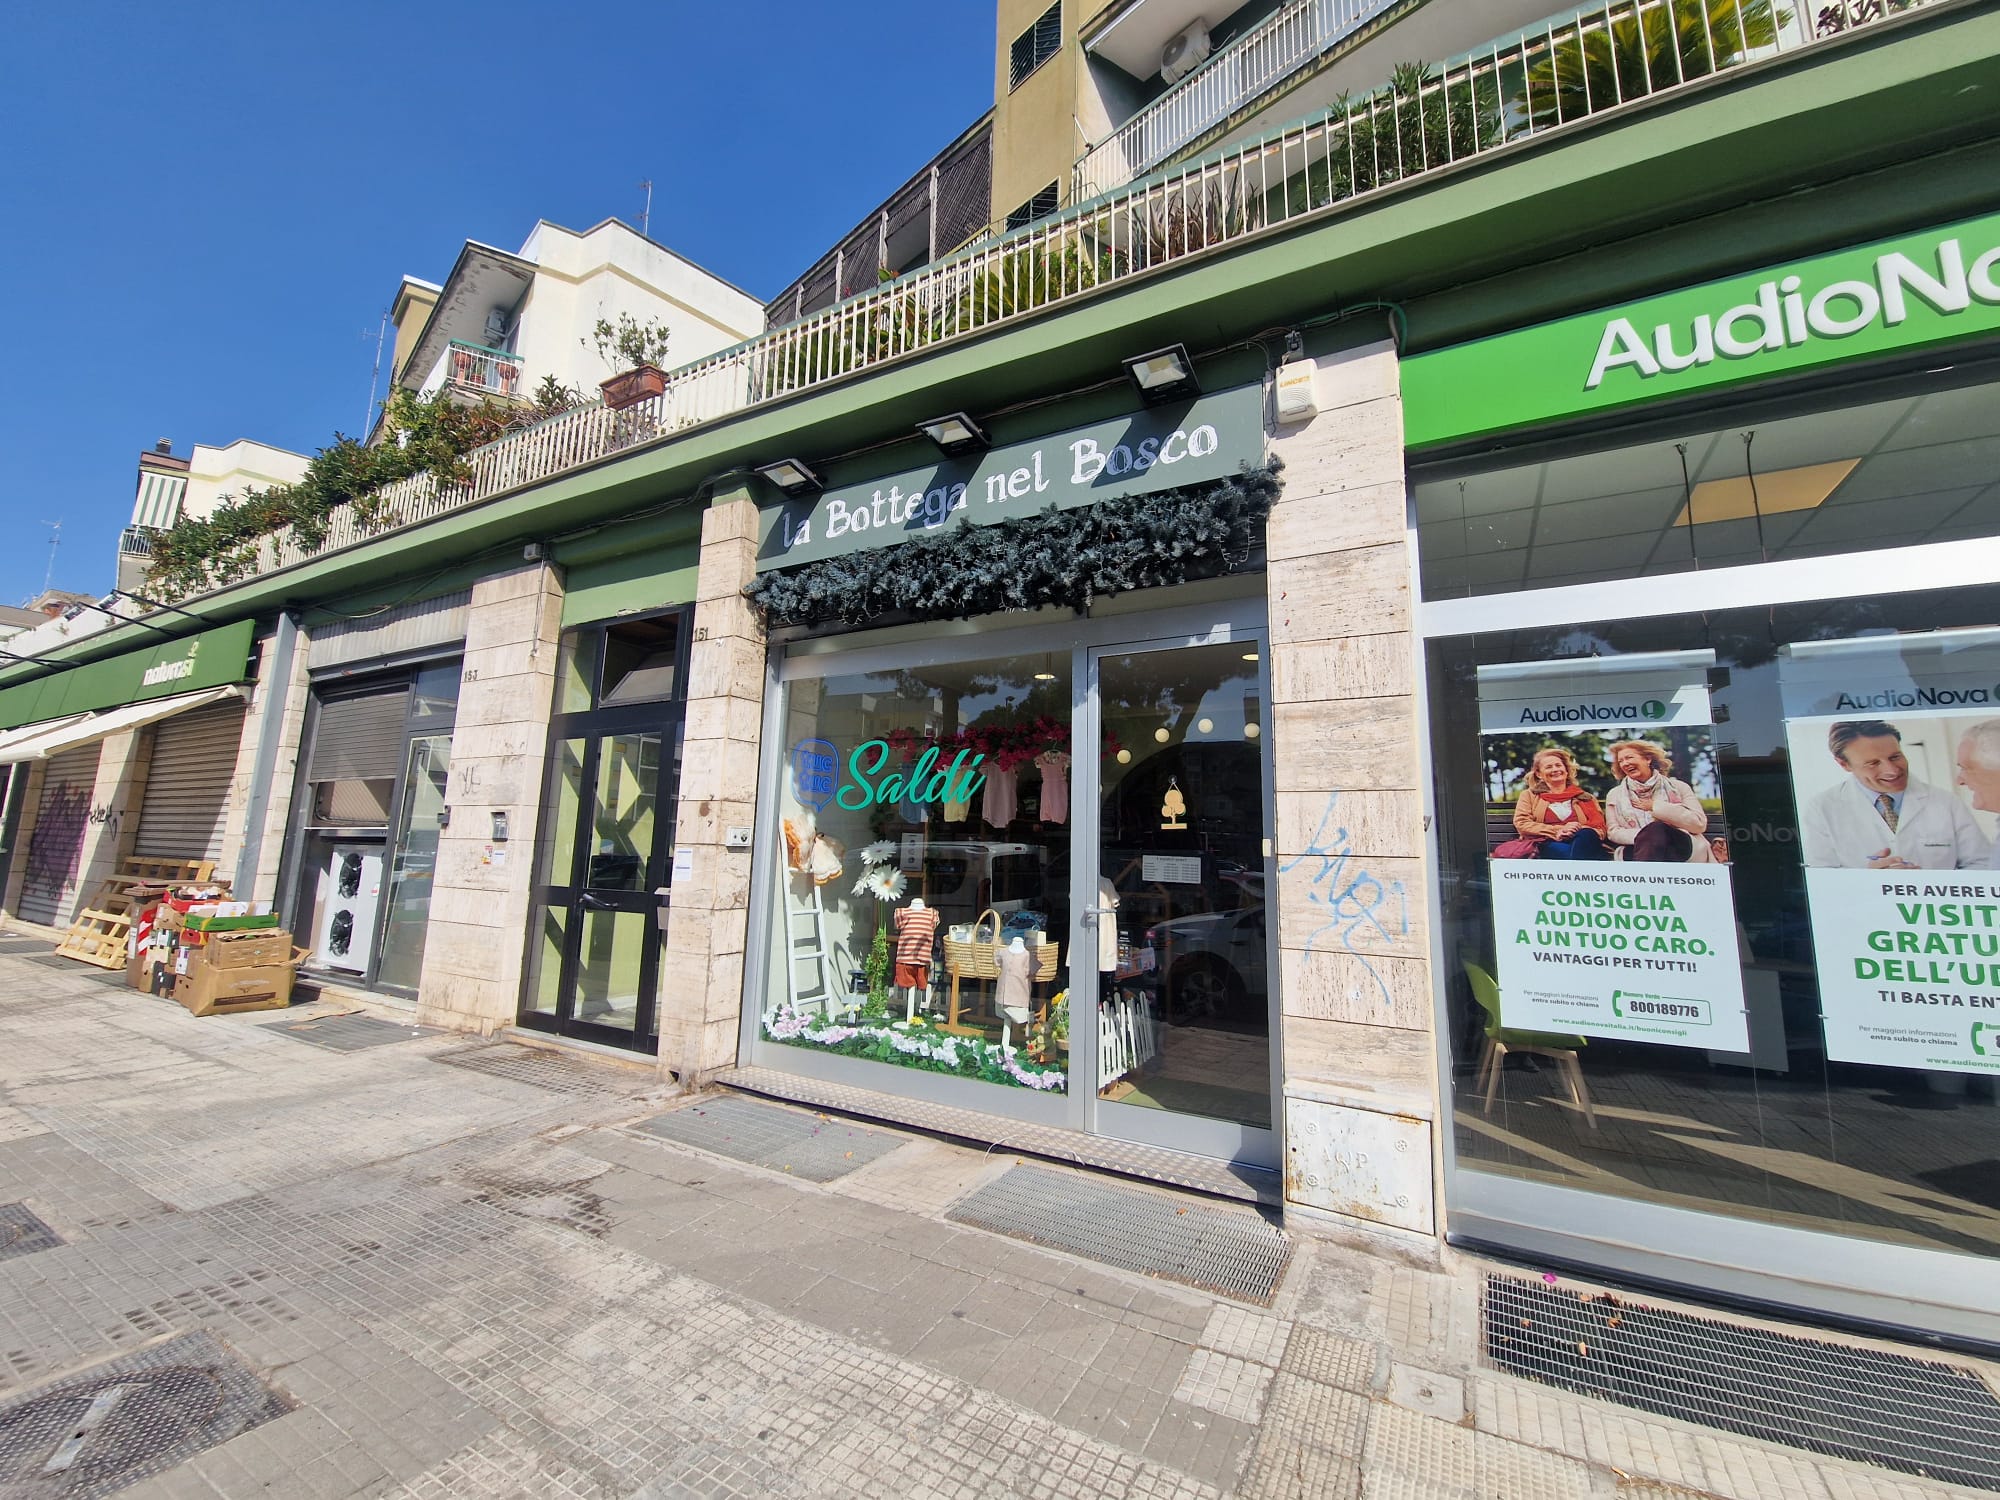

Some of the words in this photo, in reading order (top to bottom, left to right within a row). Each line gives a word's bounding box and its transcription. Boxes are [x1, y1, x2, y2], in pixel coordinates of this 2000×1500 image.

[782, 511, 811, 549] la
[825, 481, 967, 539] Bottega
[985, 450, 1050, 503] nel
[1069, 424, 1218, 485] Bosco
[694, 626, 709, 641] 151
[464, 669, 478, 682] 153
[1836, 686, 1989, 711] AudioNova
[1520, 703, 1638, 723] AudioNova
[835, 739, 987, 811] Saldi
[1574, 874, 1608, 882] AMICO
[1649, 876, 1664, 884] UN
[1667, 877, 1716, 886] TESORO!
[1882, 884, 1918, 896] PER
[1924, 886, 1985, 898] AVERE
[1541, 890, 1676, 911] CONSIGLIA
[1535, 910, 1688, 933] AUDIONOVA
[1896, 903, 2000, 928] VISIT
[1516, 929, 1530, 944] A
[1537, 930, 1570, 946] UN
[1576, 932, 1628, 950] TUO
[1634, 936, 1716, 956] CARO.
[1533, 952, 1608, 966] VANTAGGI
[1613, 957, 1642, 968] PER
[1645, 960, 1697, 972] TUTTI!
[1534, 991, 1560, 1000] maggiori
[1561, 992, 1598, 1000] informazioni
[1576, 1000, 1599, 1008] chiama
[1878, 990, 1896, 1002] TI
[1901, 991, 1964, 1007] BASTA
[1630, 1000, 1699, 1018] 800189776
[1870, 1034, 1892, 1042] entra
[1893, 1036, 1920, 1044] subito
[1928, 1038, 1958, 1046] chiama
[1872, 1026, 1907, 1036] maggiori
[1908, 1028, 1957, 1038] informazioni
